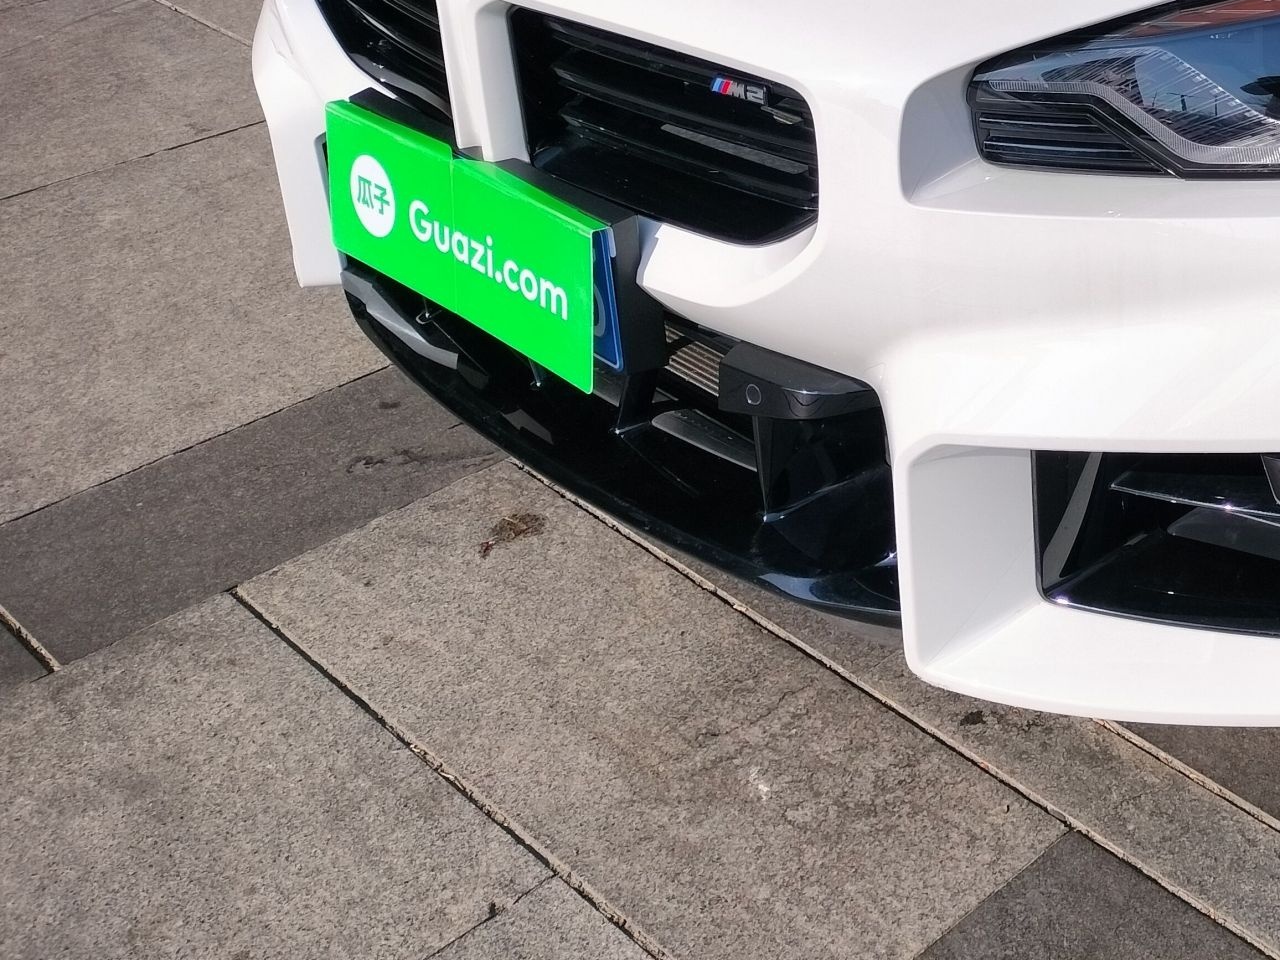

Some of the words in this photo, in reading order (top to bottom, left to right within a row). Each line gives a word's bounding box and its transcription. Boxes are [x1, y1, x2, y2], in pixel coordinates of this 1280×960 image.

[729, 80, 765, 105] M2
[357, 175, 391, 215] 瓜子
[409, 199, 569, 321] Guazi.com
